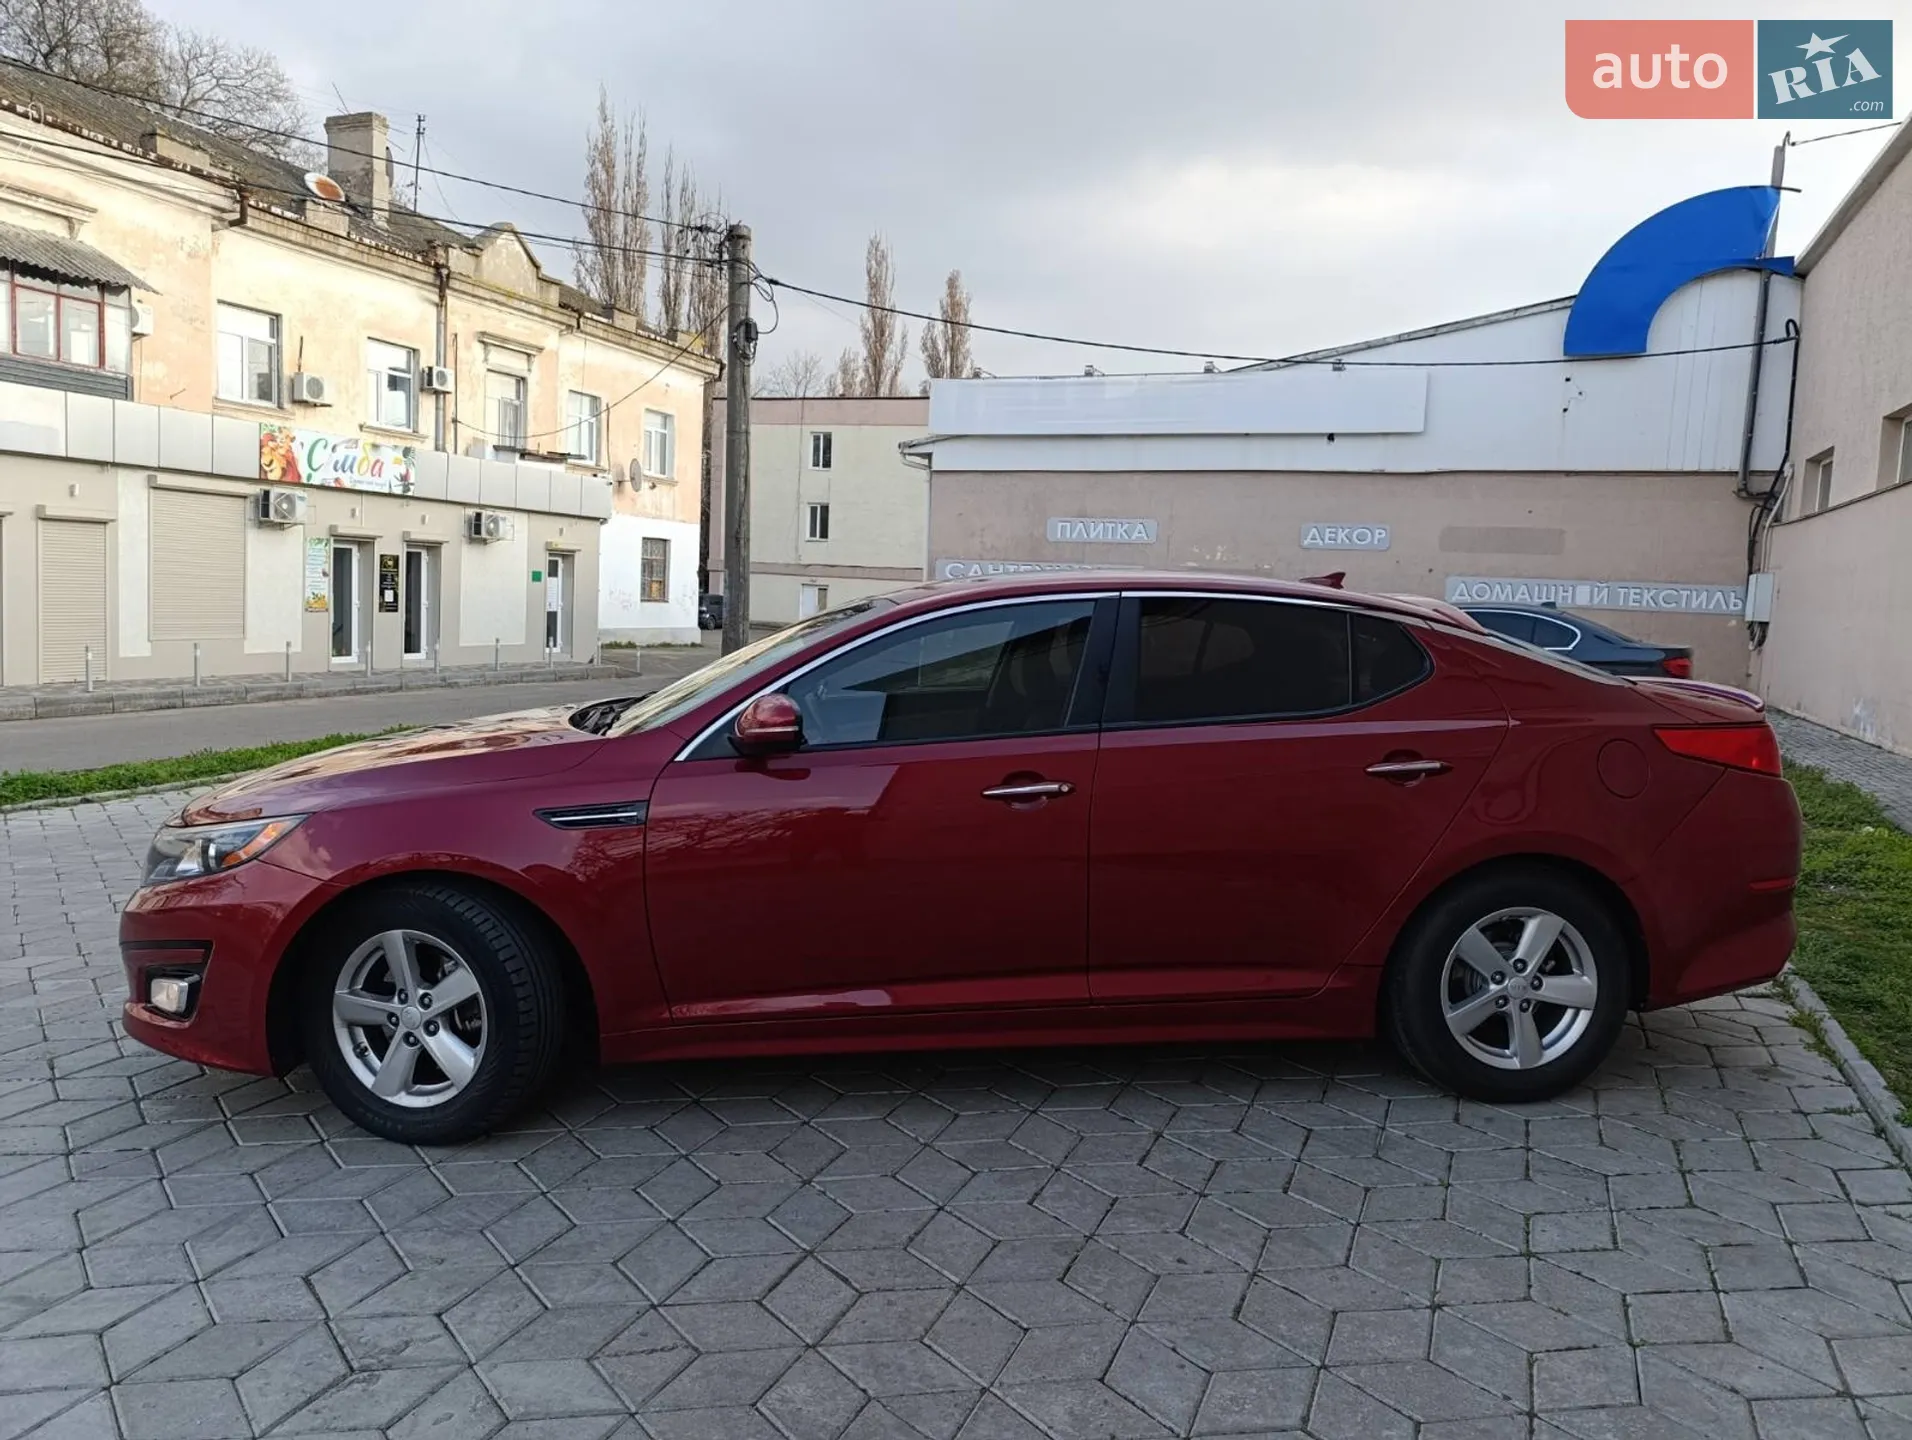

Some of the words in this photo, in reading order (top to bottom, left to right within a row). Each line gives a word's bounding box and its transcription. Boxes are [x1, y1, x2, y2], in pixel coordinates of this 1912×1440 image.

[1057, 521, 1149, 540] ПЛИТКА
[1303, 526, 1387, 546] ДЕКОР
[1451, 581, 1610, 606] ДОМАШНЙ
[1617, 587, 1743, 611] ТЕКСТИЛЬ
